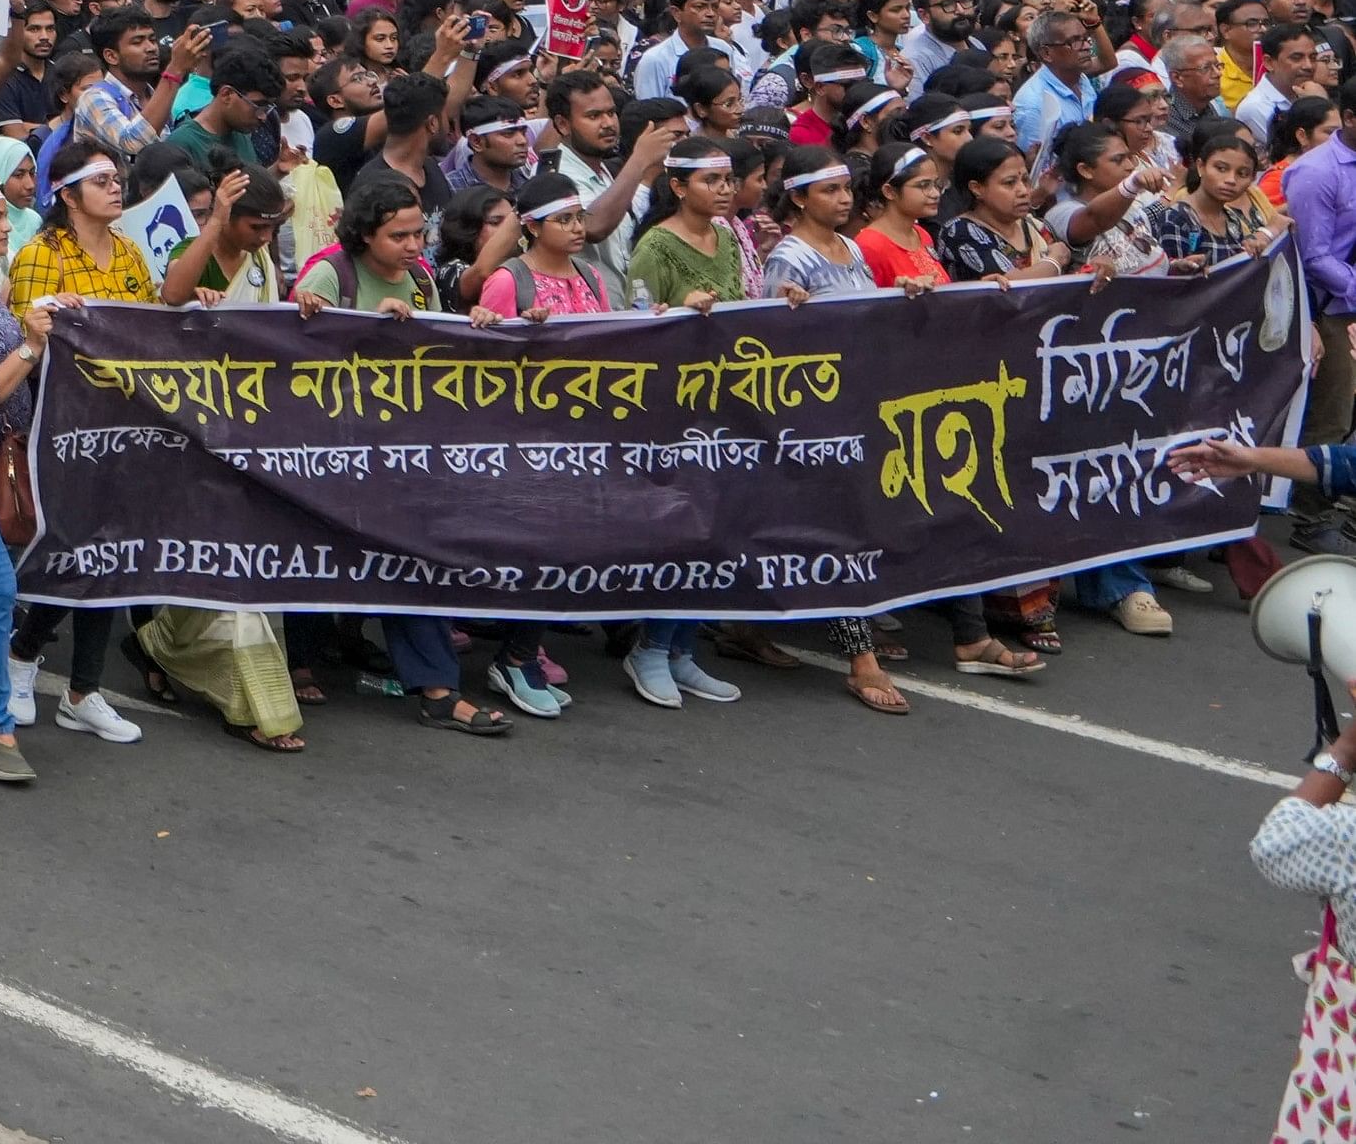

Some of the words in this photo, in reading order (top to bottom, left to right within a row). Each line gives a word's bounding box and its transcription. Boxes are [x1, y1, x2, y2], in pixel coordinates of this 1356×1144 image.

[1036, 308, 1200, 422] মিছিল
[75, 353, 277, 425] অভয়ার
[291, 344, 658, 421] ন্যায়বিচারের
[676, 336, 842, 415] দাবীতে
[879, 359, 1028, 533] মহা
[257, 443, 373, 481] সমাজের
[379, 443, 433, 475] সব
[442, 443, 508, 479] স্তরে
[517, 440, 611, 478] ভয়ের
[620, 427, 768, 479] রাজনীতির
[775, 427, 866, 469] বিরুদ্ধে
[43, 538, 145, 579] WEST
[152, 538, 341, 582] BENGAL
[348, 548, 520, 594] JUNIOR
[754, 548, 886, 590] FRONT
